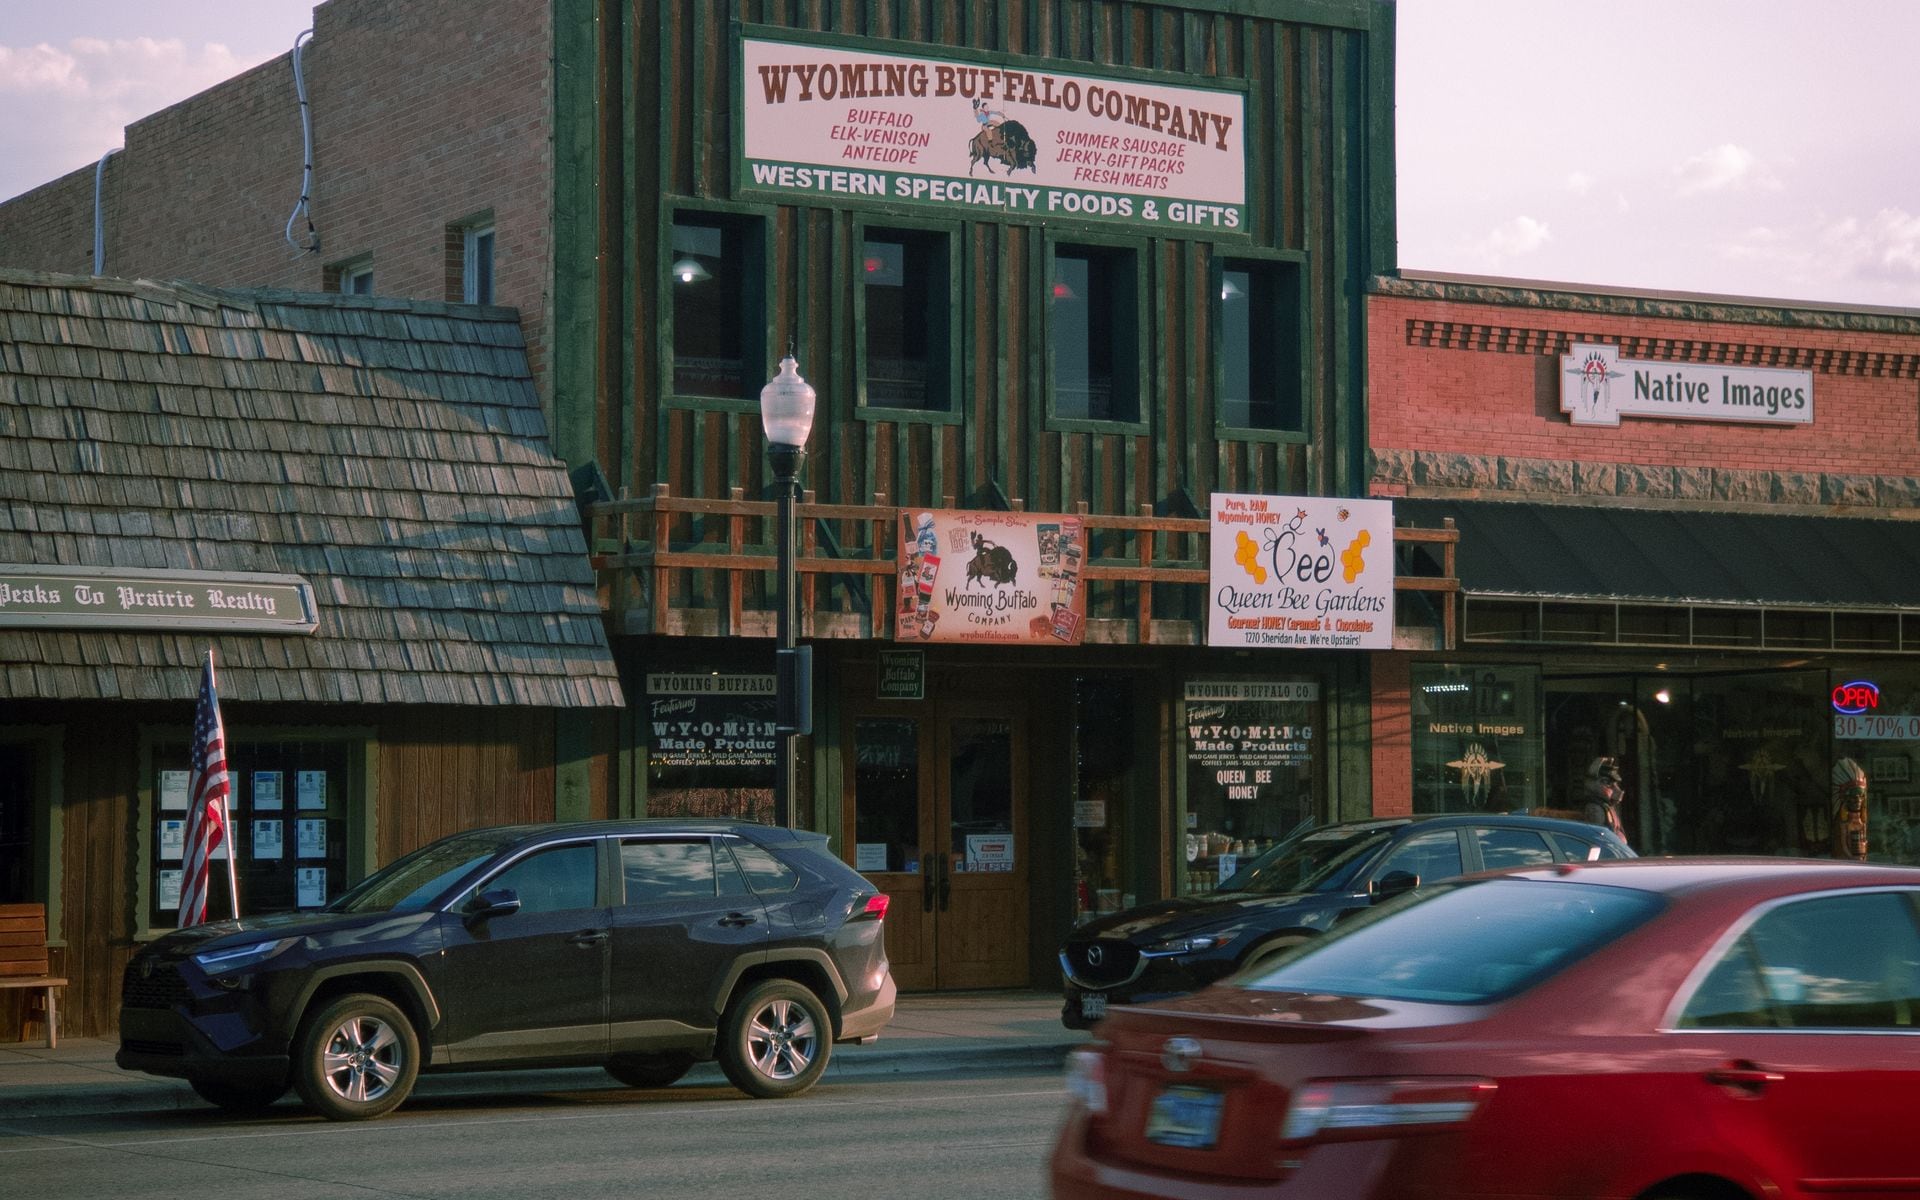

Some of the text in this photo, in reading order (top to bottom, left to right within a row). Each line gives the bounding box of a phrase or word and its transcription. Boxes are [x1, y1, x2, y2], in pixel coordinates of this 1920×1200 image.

[758, 63, 1232, 152] WYOMING BUFFALO COMPANY
[847, 108, 913, 128] BUFFALO
[830, 126, 930, 148] ELK-VENISON
[1056, 130, 1186, 158] SUMMER SAUSAGE
[842, 145, 919, 164] ANTELOPE
[1056, 149, 1185, 175] JERKY-GIFT PACKS
[1074, 167, 1168, 190] FRESH MEATS
[752, 163, 1239, 228] WESTERN SPECIALTY FOODS & GIFTS
[1634, 370, 1805, 415] Native Images
[1249, 499, 1268, 511] RAW
[974, 514, 1004, 526] Sample
[1217, 511, 1281, 526] Wyoming HONEY
[1271, 530, 1336, 585] Bee
[74, 584, 105, 605] To
[116, 585, 194, 610] Prairie
[206, 589, 277, 615] Realty
[945, 587, 1037, 616] Wyoming Buffalo
[1217, 585, 1386, 618] Queen Bee Gardens
[967, 612, 1012, 627] COMPANY
[1228, 616, 1374, 632] Gourmet HONEY Caramels & Chocolates
[1245, 632, 1260, 644] 1270
[1261, 632, 1293, 645] Sheridan
[1309, 634, 1329, 645] We're
[1330, 634, 1361, 647] Upstairs!
[652, 677, 773, 691] WYOMING BUFFALO
[881, 678, 920, 697] Company
[1188, 685, 1238, 698] WYOMING
[1244, 685, 1290, 698] BUFFALO
[1832, 686, 1878, 708] OPEN
[650, 698, 696, 718] Featuring
[1187, 703, 1226, 724] Featuring
[1429, 722, 1524, 737] Native Images
[1836, 717, 1904, 738] 30-70%
[659, 738, 706, 750] Made
[1194, 741, 1307, 751] Made Products
[1216, 770, 1272, 785] QUEEN BEE
[1228, 786, 1258, 799] HONEY
